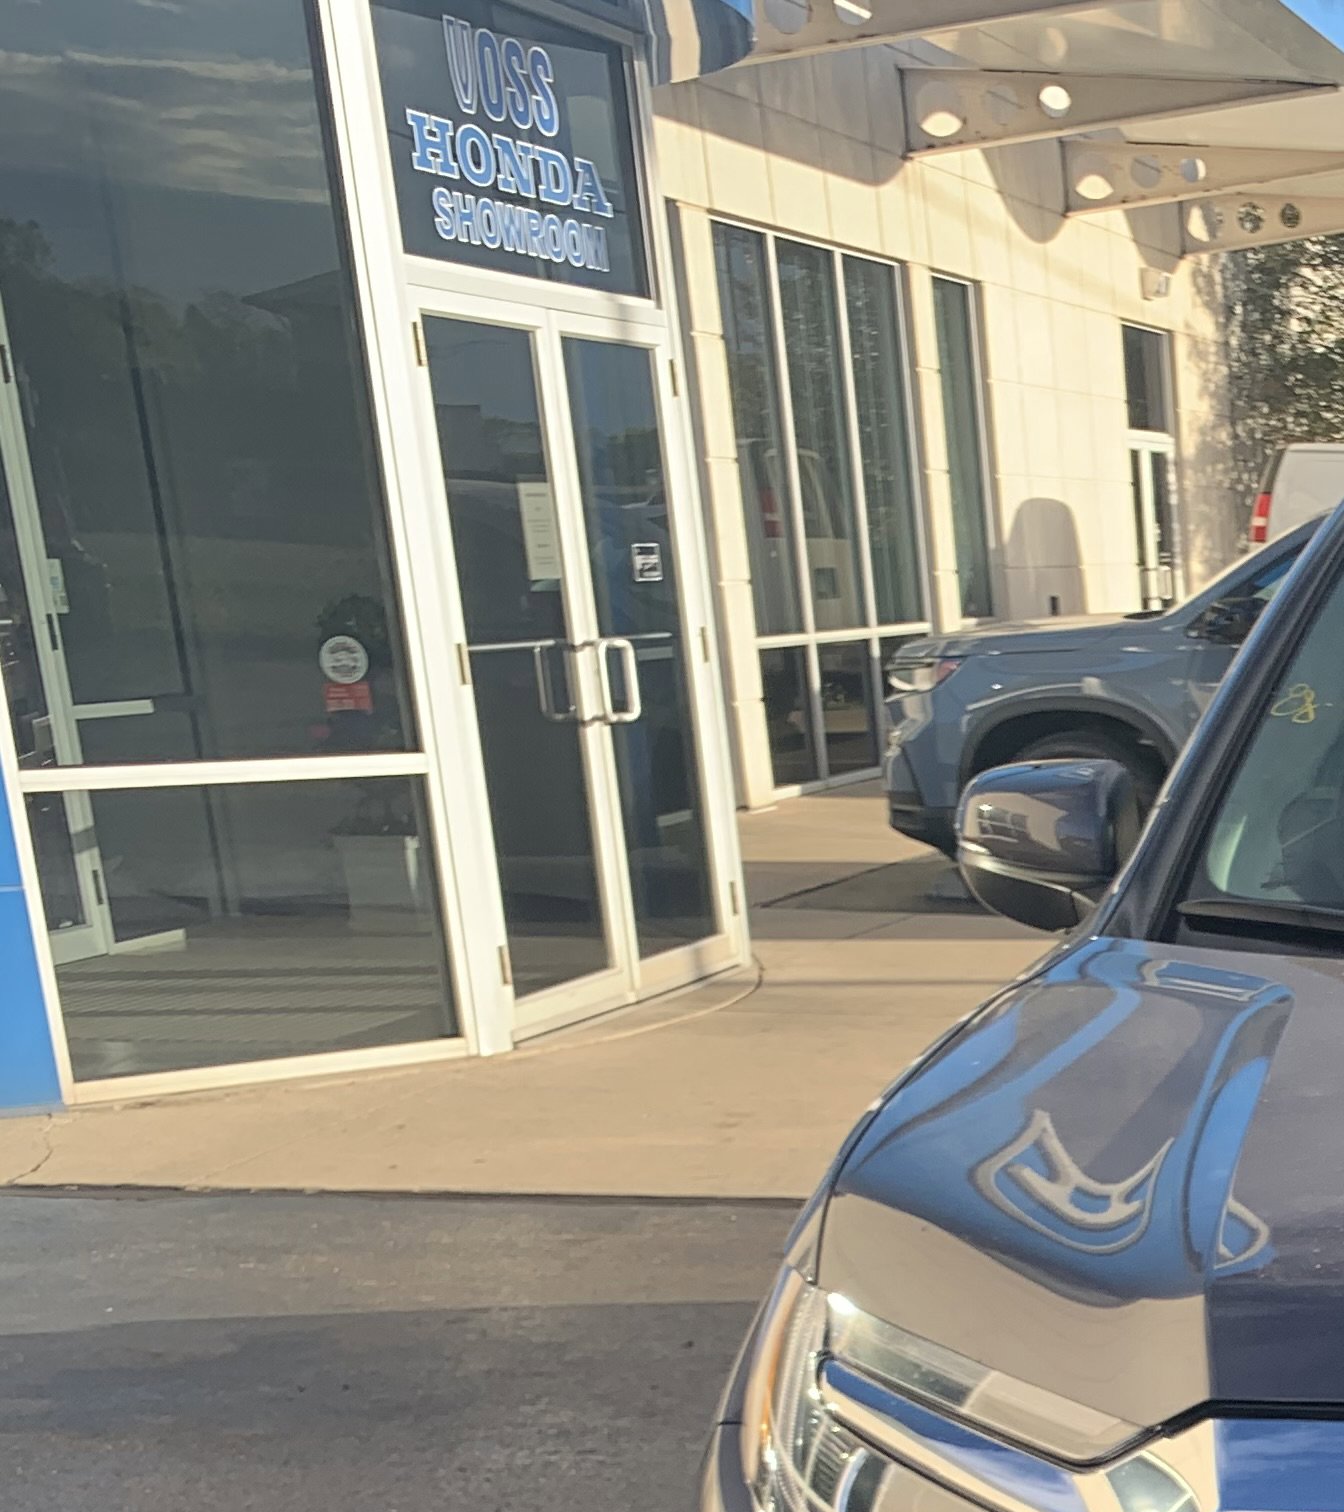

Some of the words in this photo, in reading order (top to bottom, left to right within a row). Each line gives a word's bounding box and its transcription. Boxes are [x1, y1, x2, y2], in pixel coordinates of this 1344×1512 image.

[442, 14, 559, 137] VOSS
[405, 108, 614, 218] HONDA
[432, 187, 610, 272] SHOWROOM
